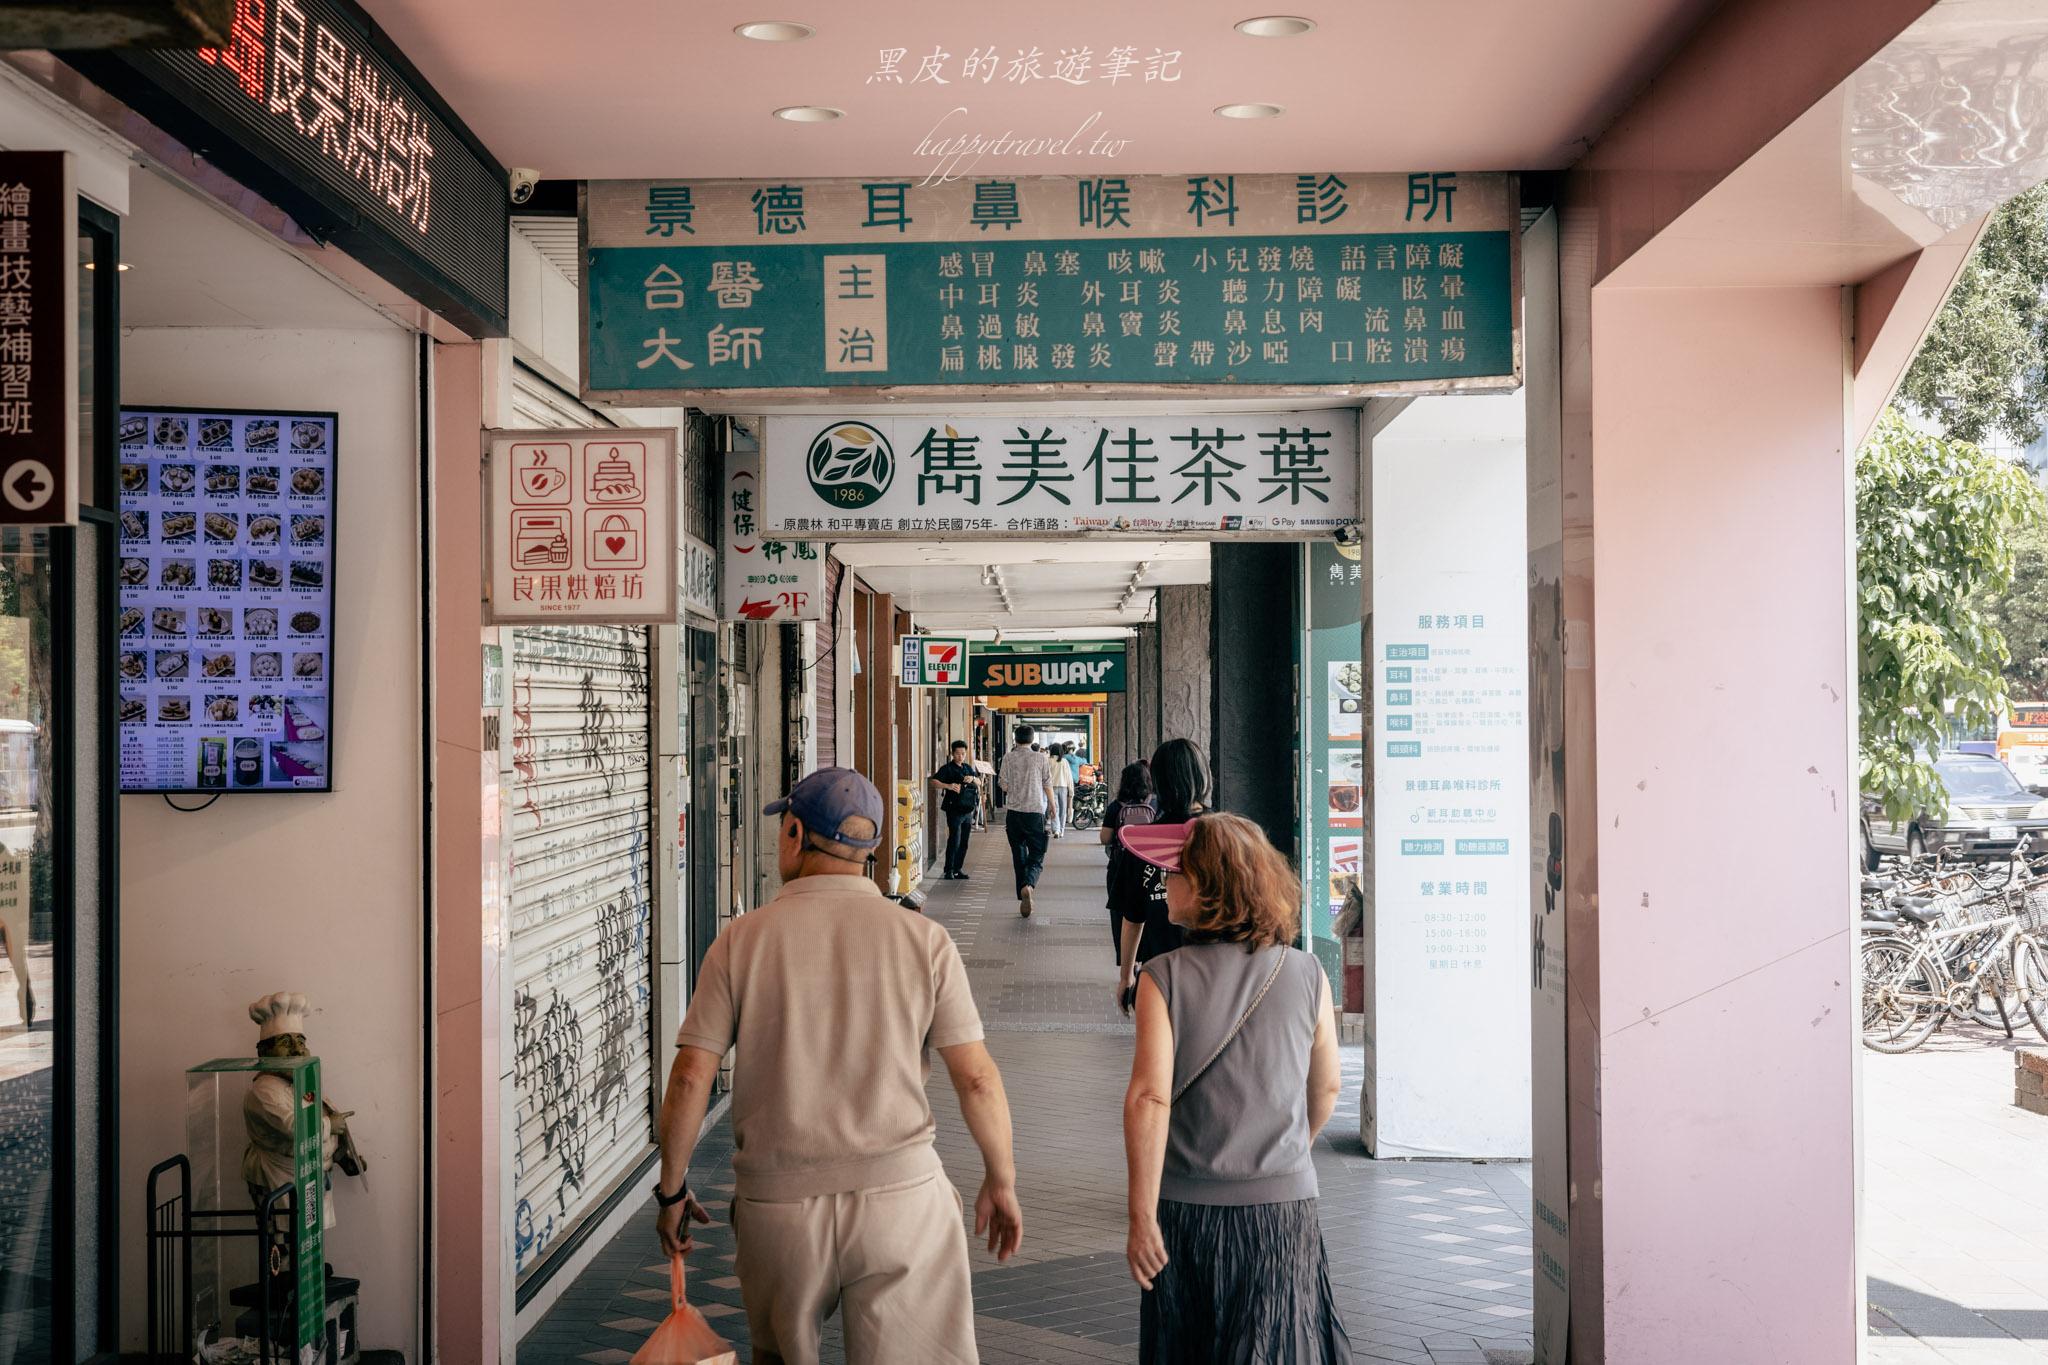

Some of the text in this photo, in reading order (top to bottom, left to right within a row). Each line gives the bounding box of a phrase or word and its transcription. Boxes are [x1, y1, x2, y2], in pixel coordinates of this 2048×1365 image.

[644, 171, 1458, 237] 景德耳鼻喉科診所
[938, 243, 1464, 278] 感冒 鼻塞 咳嗽 小兒發燒 語言障礙
[940, 275, 1465, 309] 中耳炎 外耳炎 聽力障礙 眩暈
[0, 182, 32, 435] 繪畫技藝補習班
[838, 265, 875, 363] 主治
[940, 305, 1465, 341] 鼻過敏 鼻竇炎 鼻息肉 流鼻血
[940, 337, 1466, 371] 扁桃腺發炎 聲帶沙啞 口腔潰瘍
[910, 425, 1332, 506] 雋美佳茶葉
[833, 488, 865, 502] 1986
[783, 518, 823, 531] 原農林
[828, 518, 893, 531] 和平專賣店
[513, 574, 643, 601] 良果烘焙坊
[540, 604, 581, 612] SINCE 1977
[1418, 615, 1485, 629] 服務項目
[1388, 647, 1426, 657] 主治項目
[983, 660, 1114, 688] SUBWAY
[1389, 670, 1408, 679] 耳科
[1406, 779, 1501, 791] 景德耳鼻喉科診所
[1421, 881, 1488, 896] 營業時間
